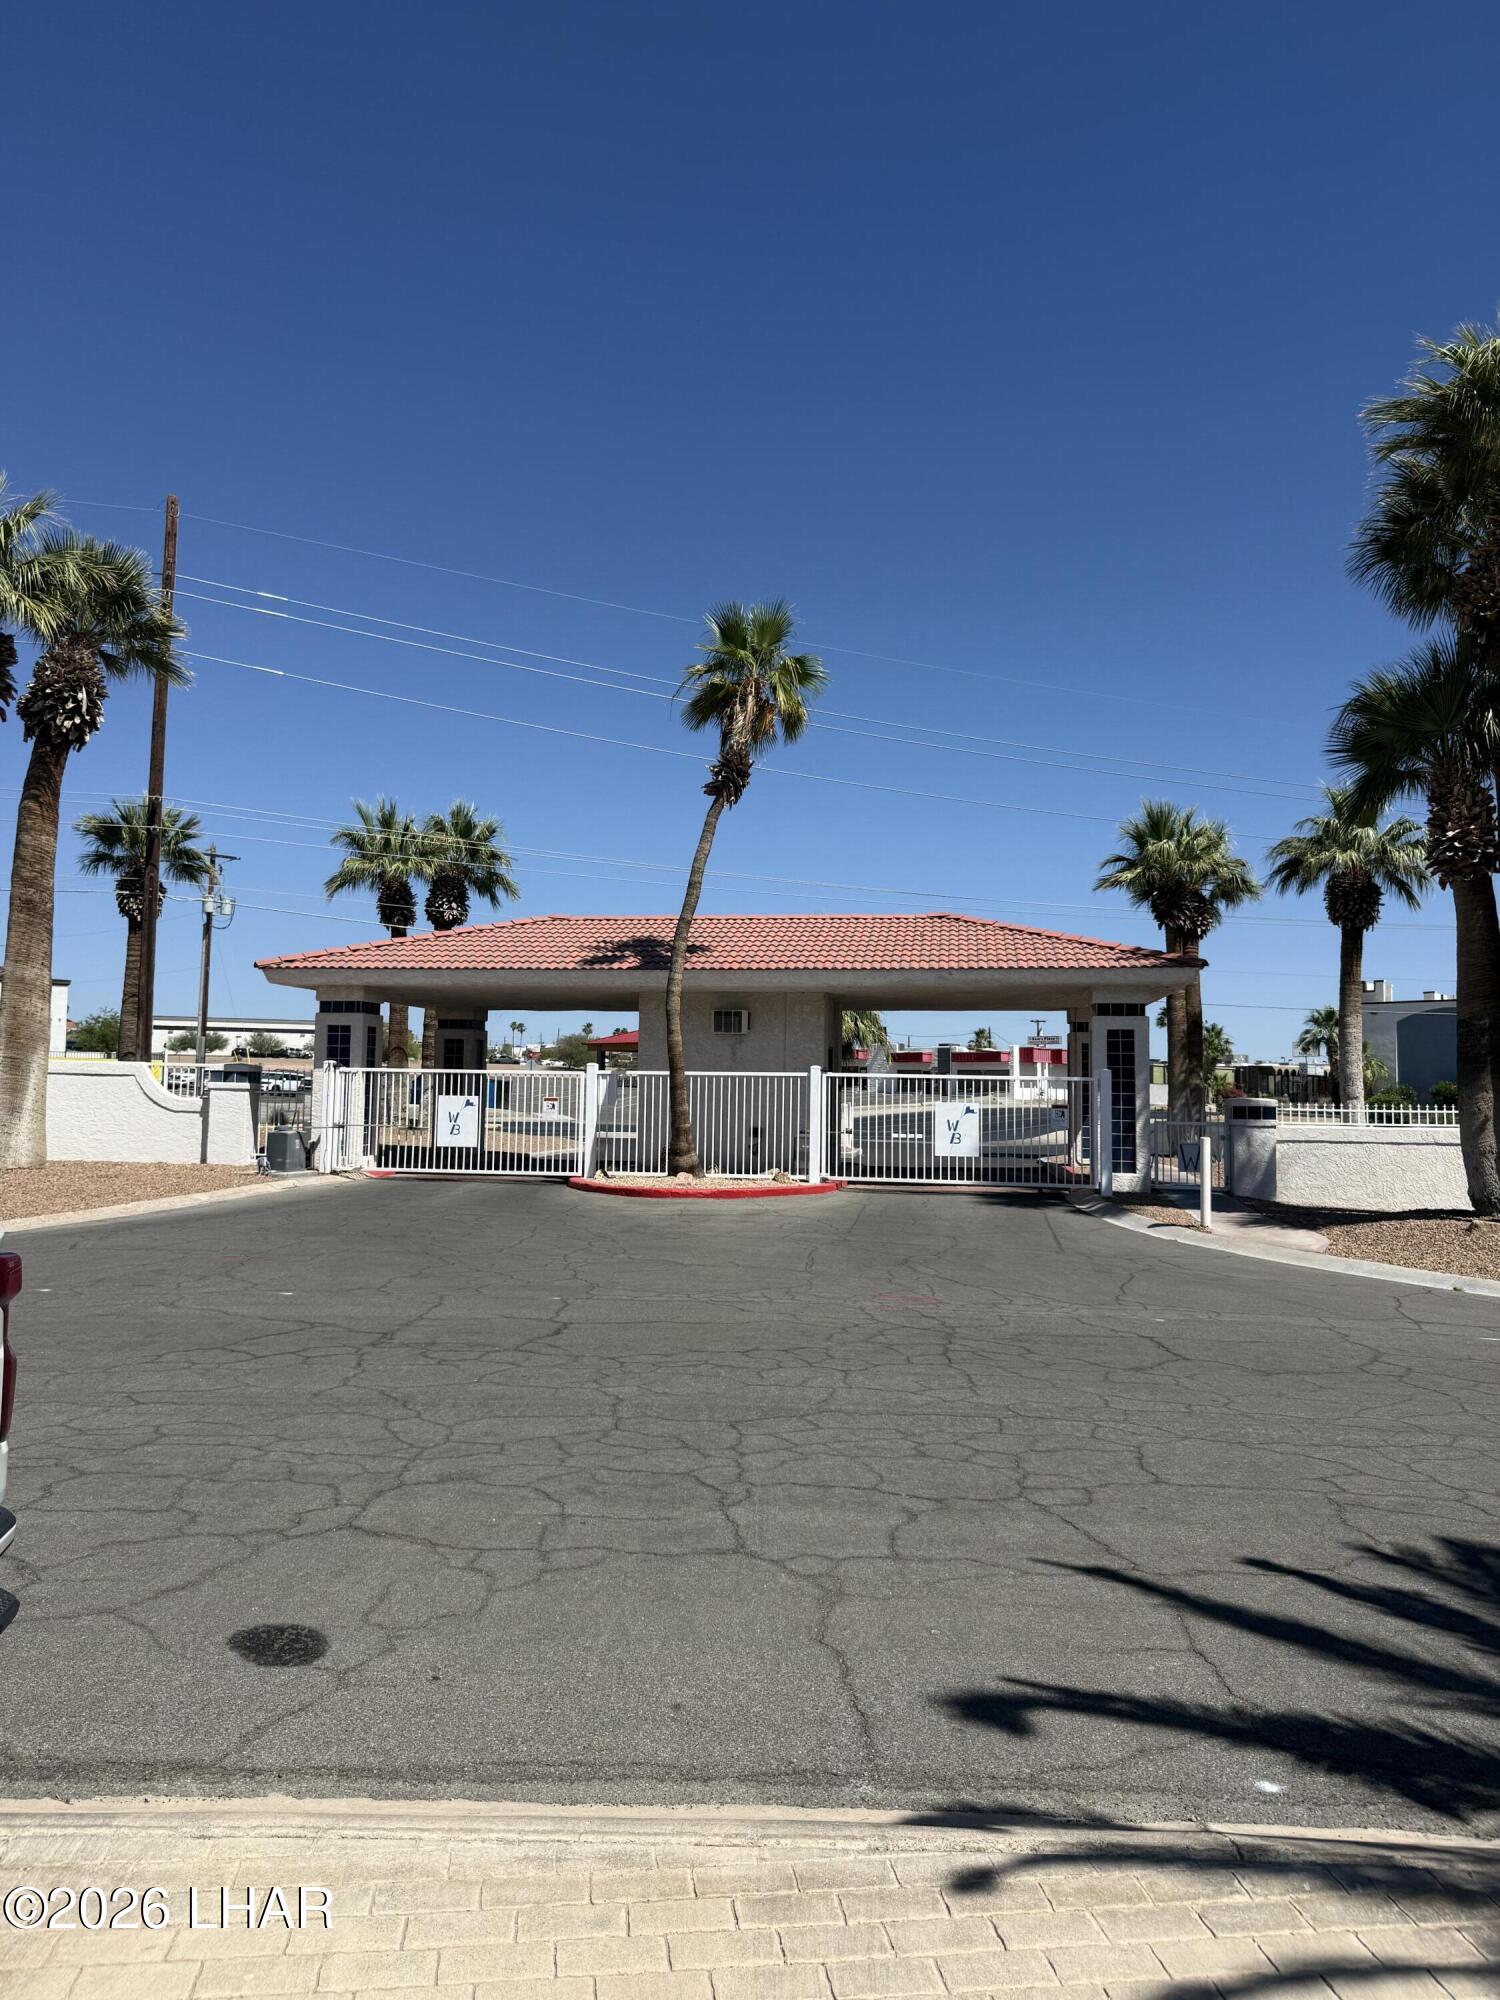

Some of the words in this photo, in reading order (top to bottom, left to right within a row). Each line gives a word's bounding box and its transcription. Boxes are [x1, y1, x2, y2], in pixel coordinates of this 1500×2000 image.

[448, 1112, 460, 1123] W
[450, 1124, 461, 1135] B
[947, 1120, 960, 1131] W
[950, 1133, 962, 1144] B
